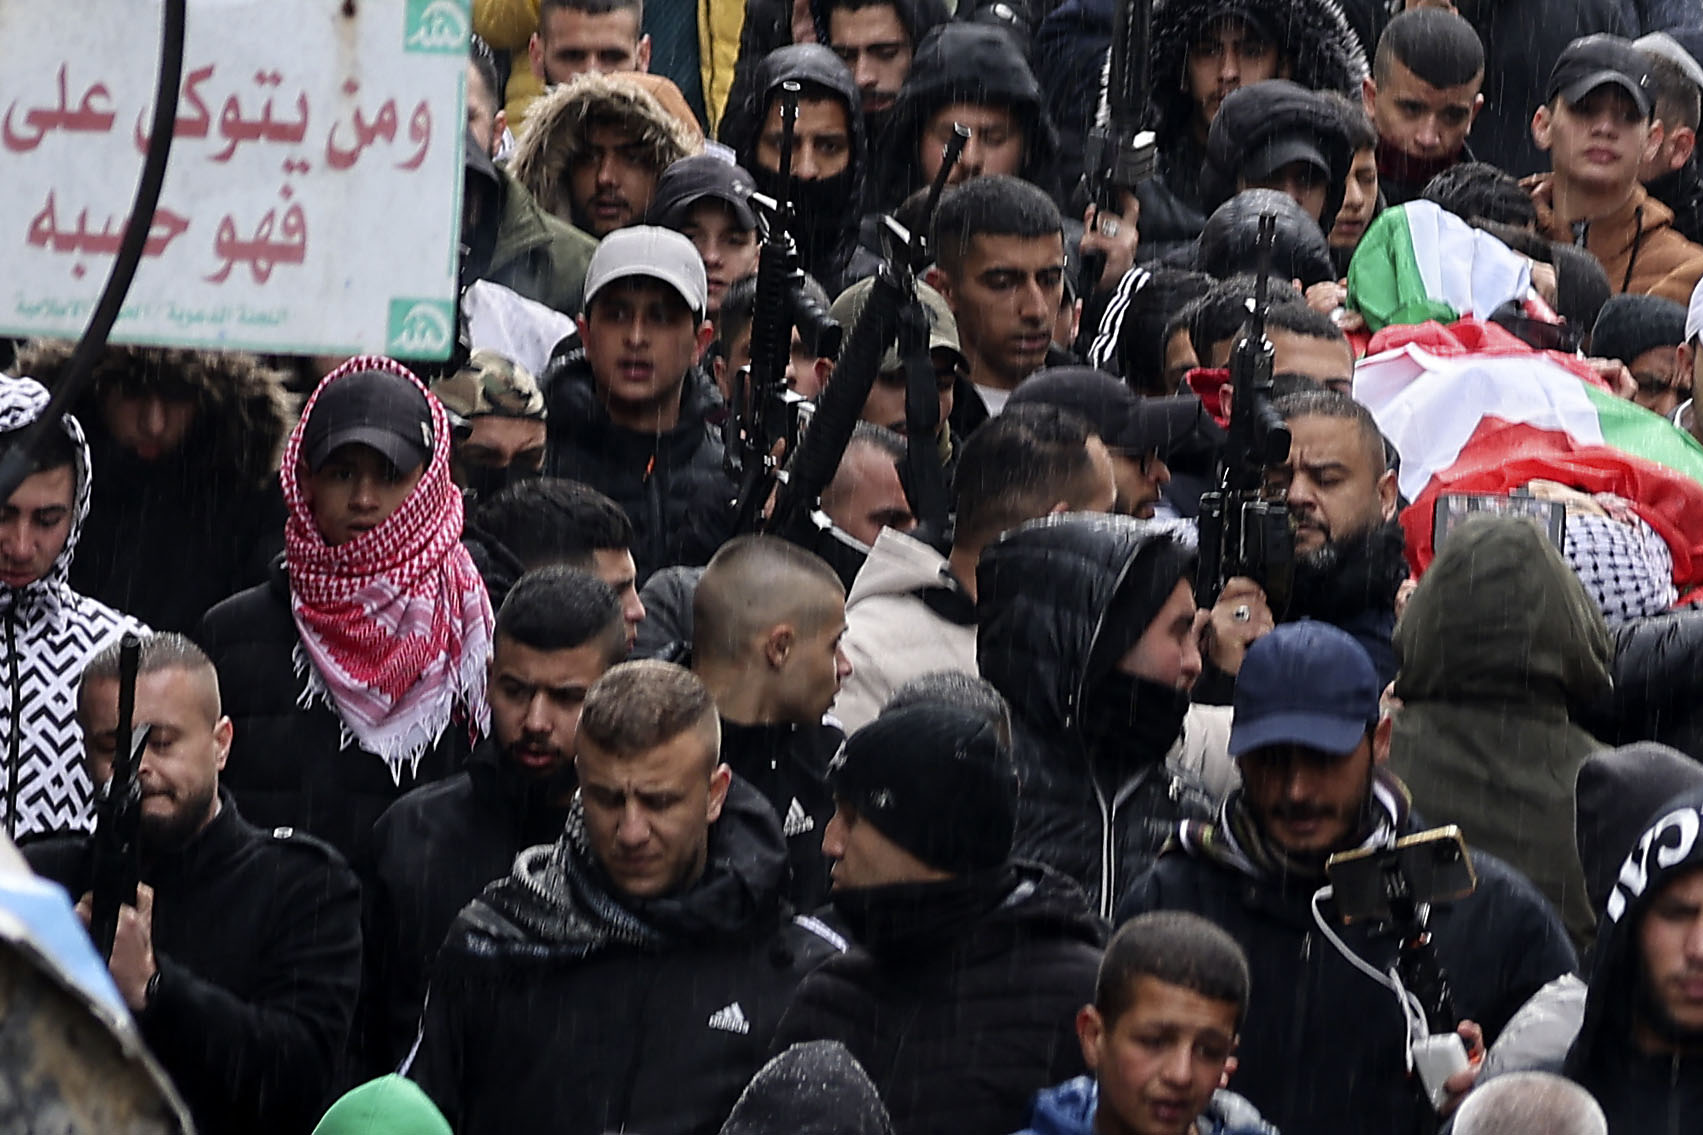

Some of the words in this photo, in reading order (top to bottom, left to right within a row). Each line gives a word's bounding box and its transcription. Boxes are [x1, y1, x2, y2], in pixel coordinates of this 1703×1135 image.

[2, 62, 116, 154] على
[325, 76, 432, 171] ومن
[203, 182, 308, 285] فهو
